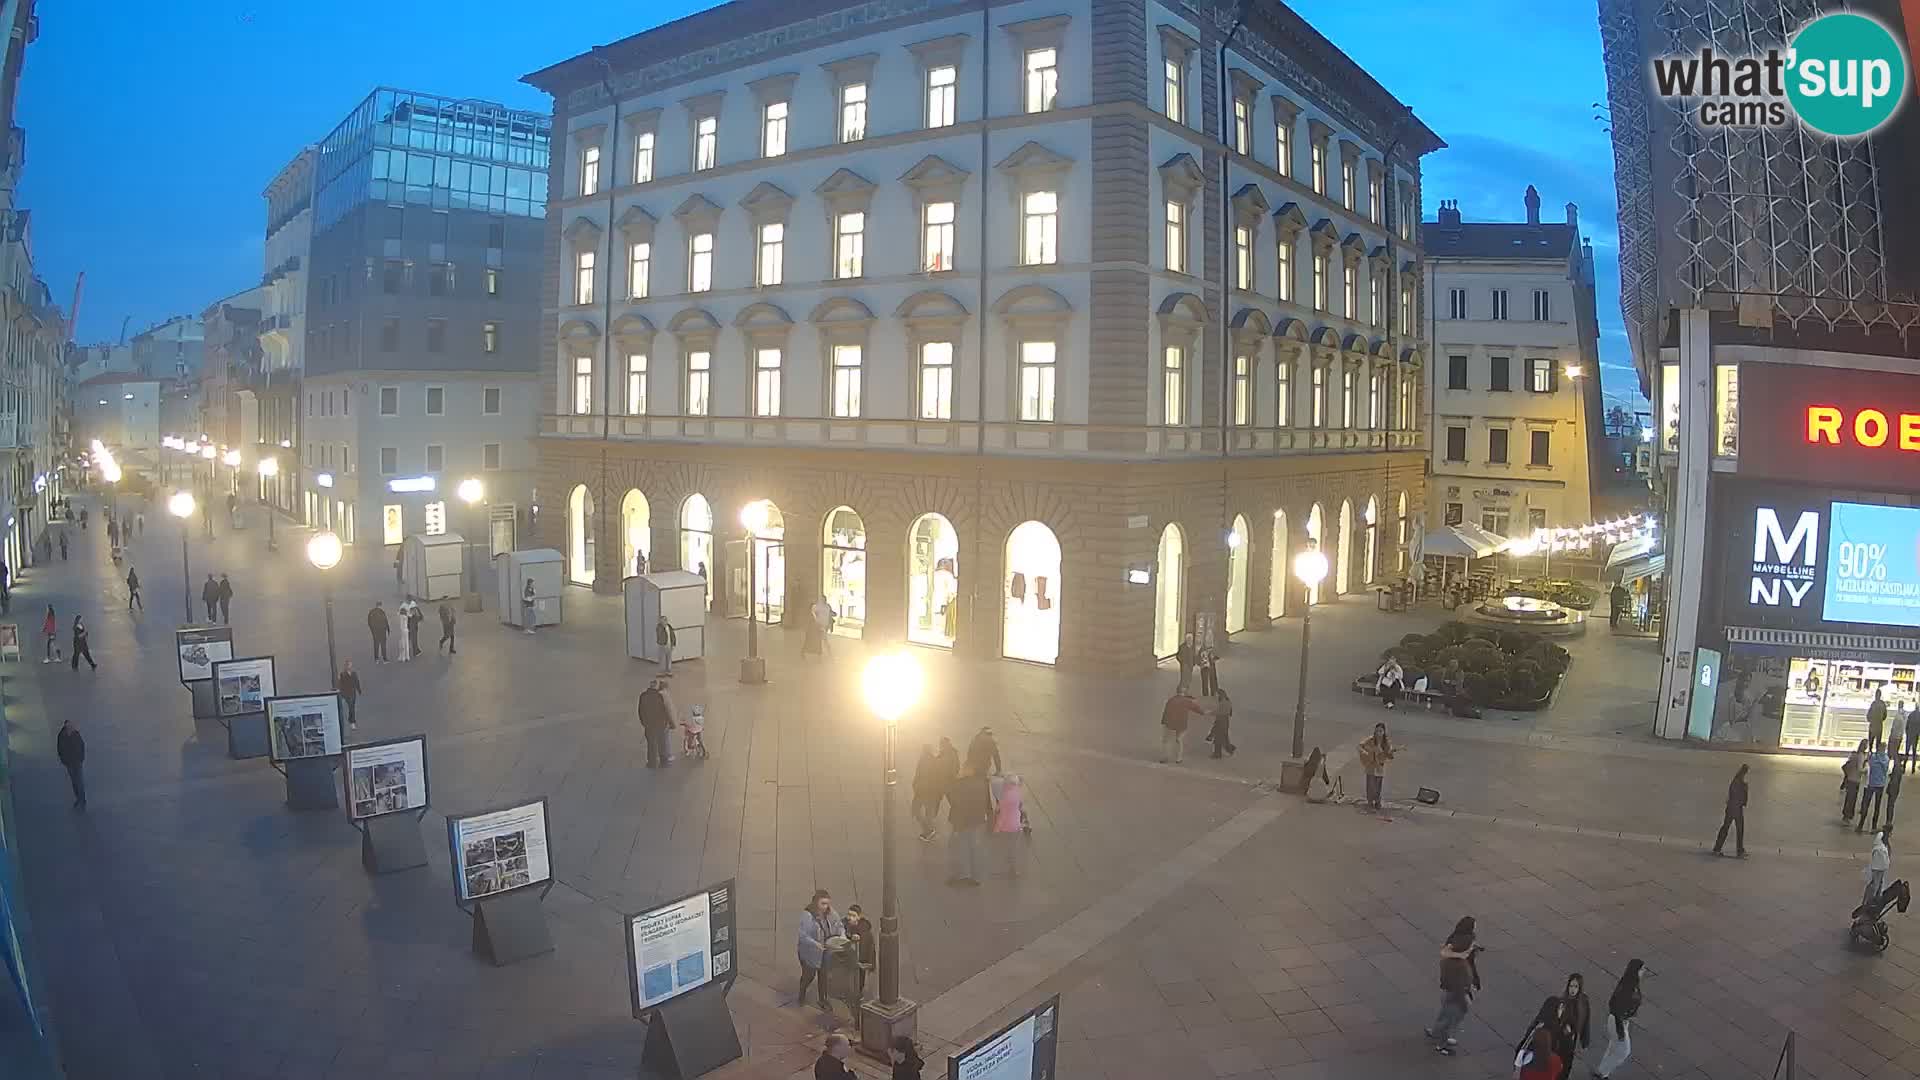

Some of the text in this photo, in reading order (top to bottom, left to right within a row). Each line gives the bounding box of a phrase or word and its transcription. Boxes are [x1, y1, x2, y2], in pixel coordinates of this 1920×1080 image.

[1754, 508, 1819, 566] M
[1752, 564, 1815, 577] MAYBELLINE
[1838, 541, 1887, 581] 90%
[1750, 577, 1815, 607] NY
